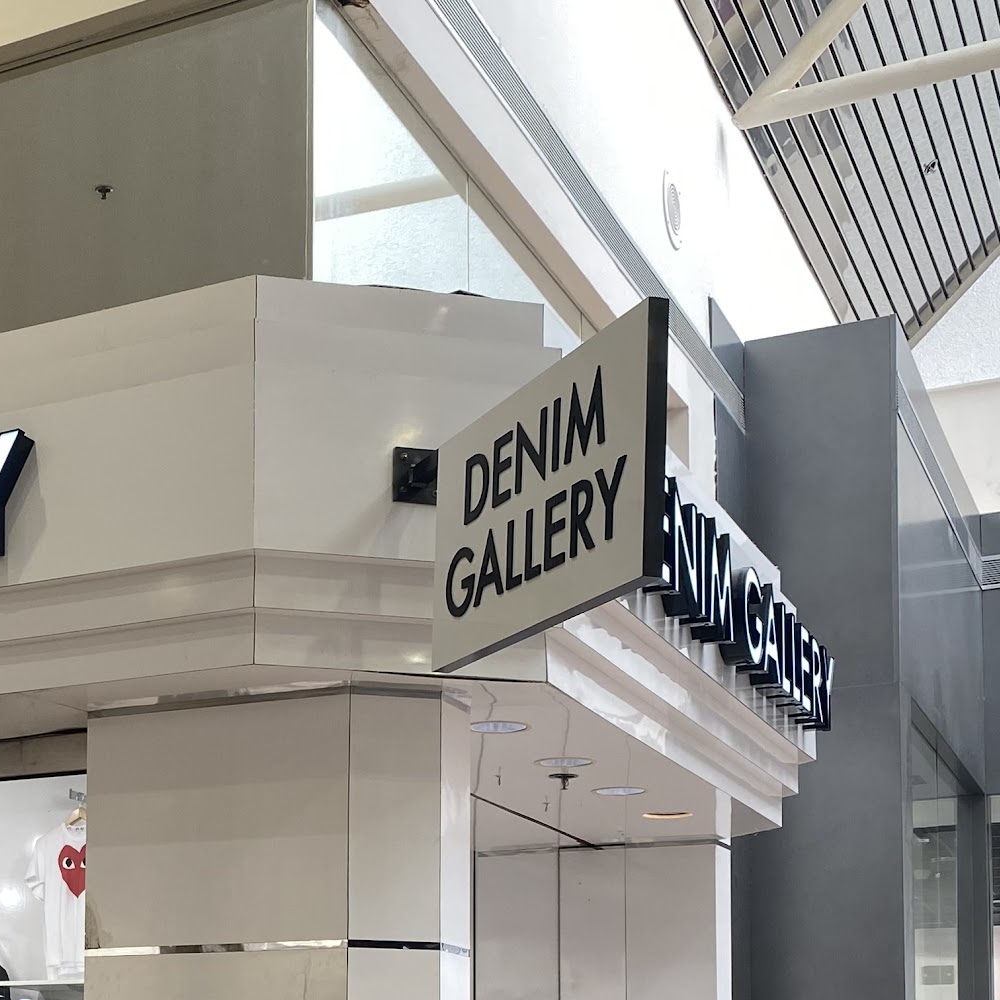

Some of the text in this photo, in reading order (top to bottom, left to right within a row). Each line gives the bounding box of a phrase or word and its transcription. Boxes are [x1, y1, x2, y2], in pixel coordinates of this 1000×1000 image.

[463, 364, 606, 526] DENIM
[445, 454, 627, 618] GALLERY
[662, 475, 834, 728] NIM GALLERY
